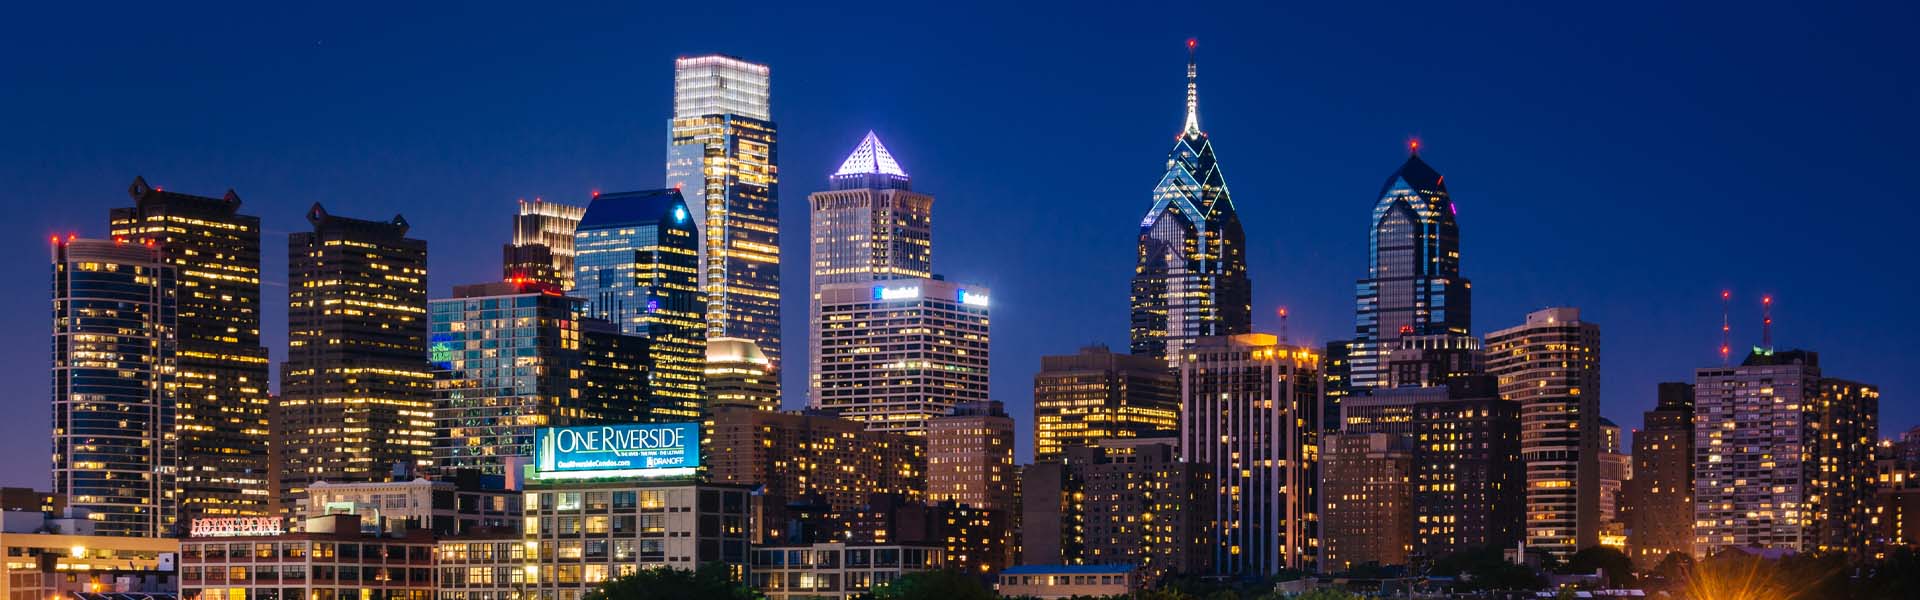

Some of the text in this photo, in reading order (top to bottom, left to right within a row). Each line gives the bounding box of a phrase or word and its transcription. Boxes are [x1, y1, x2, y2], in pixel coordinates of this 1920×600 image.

[557, 426, 685, 457] ONE RIVERSIDE
[654, 457, 684, 465] DRANOFF
